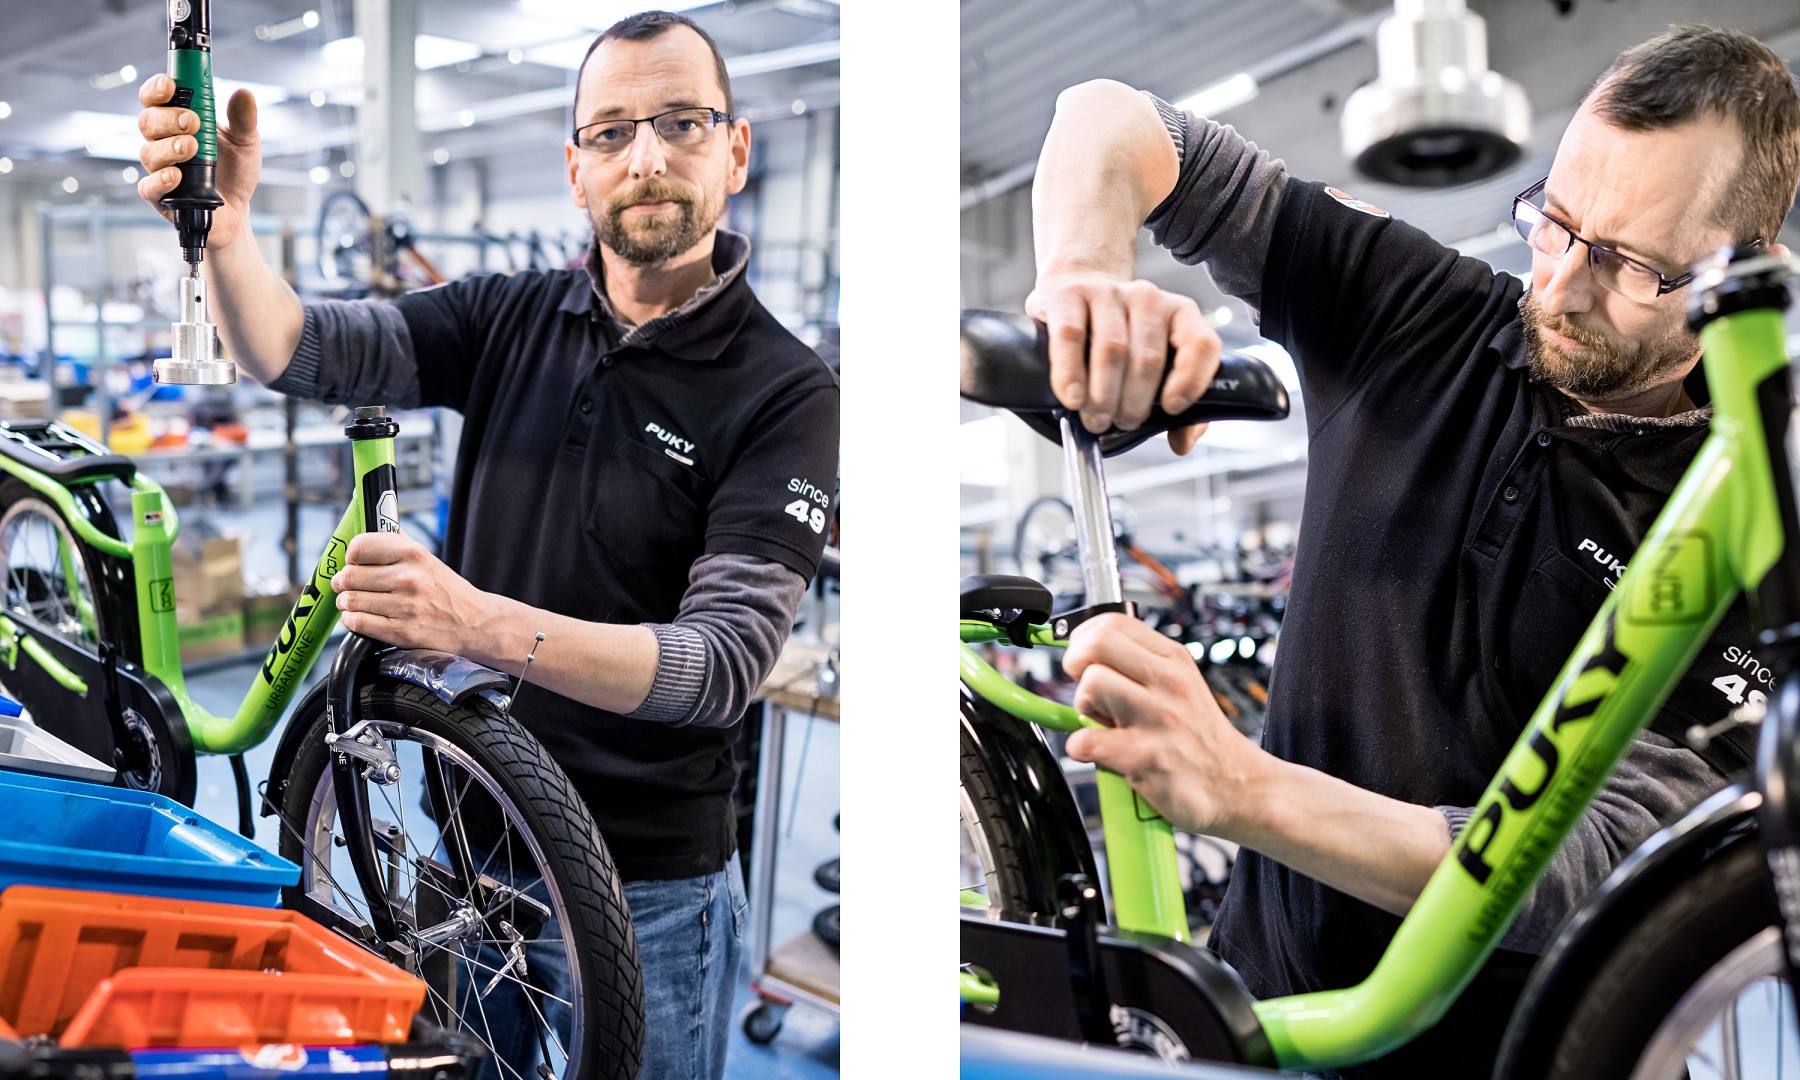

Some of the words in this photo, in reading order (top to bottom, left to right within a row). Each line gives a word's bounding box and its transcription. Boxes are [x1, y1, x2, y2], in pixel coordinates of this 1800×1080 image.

[645, 422, 695, 453] PUKY
[787, 477, 829, 508] since
[784, 499, 826, 534] 49
[1577, 538, 1627, 580] PUK
[262, 563, 321, 685] PUKY
[265, 661, 297, 710] URBAN
[294, 632, 315, 666] LINE
[1457, 606, 1629, 885] PUKY
